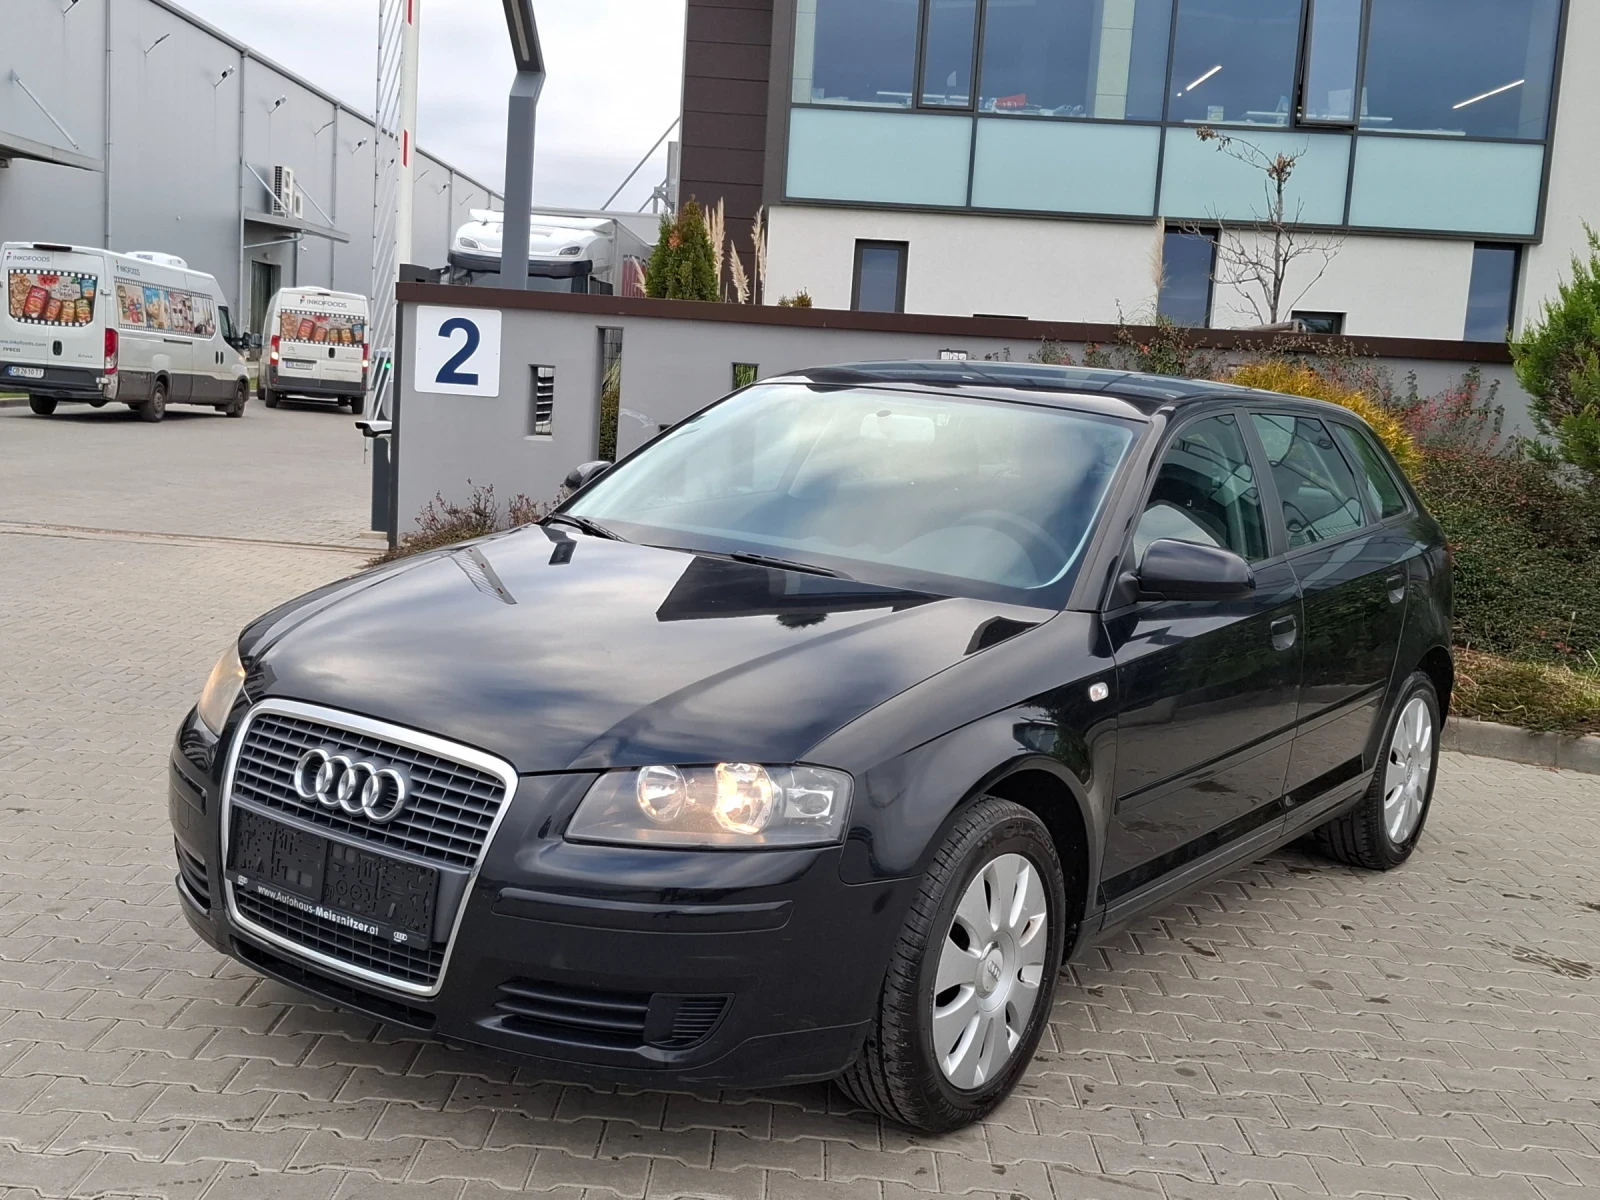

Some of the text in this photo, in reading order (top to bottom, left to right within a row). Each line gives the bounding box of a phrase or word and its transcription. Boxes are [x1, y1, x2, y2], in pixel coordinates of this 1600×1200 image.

[13, 255, 51, 263] INKOFOODS
[307, 299, 347, 308] INKOFOODS
[435, 317, 480, 386] 2
[257, 885, 379, 936] www.Autohaus-Meissnitzer.at
